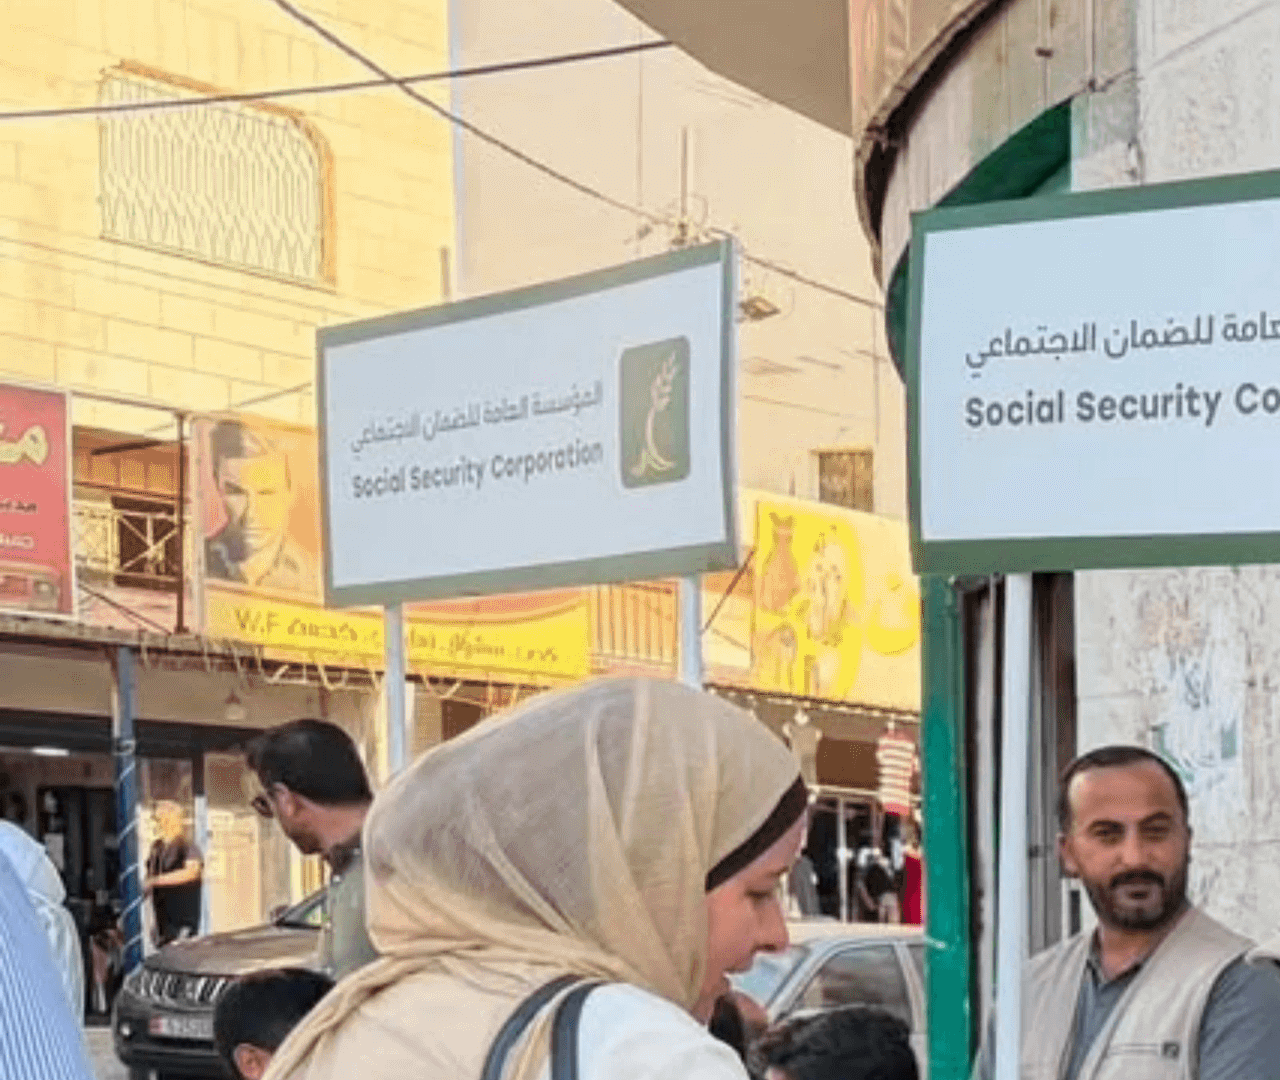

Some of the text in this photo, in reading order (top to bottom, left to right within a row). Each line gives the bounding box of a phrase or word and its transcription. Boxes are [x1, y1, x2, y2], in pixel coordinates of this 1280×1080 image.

[965, 321, 1097, 380] الاجتماعي
[1103, 313, 1215, 360] للضمان
[965, 388, 1065, 429] Social
[1075, 382, 1223, 428] Security
[353, 438, 603, 499] Social Security Corporation
